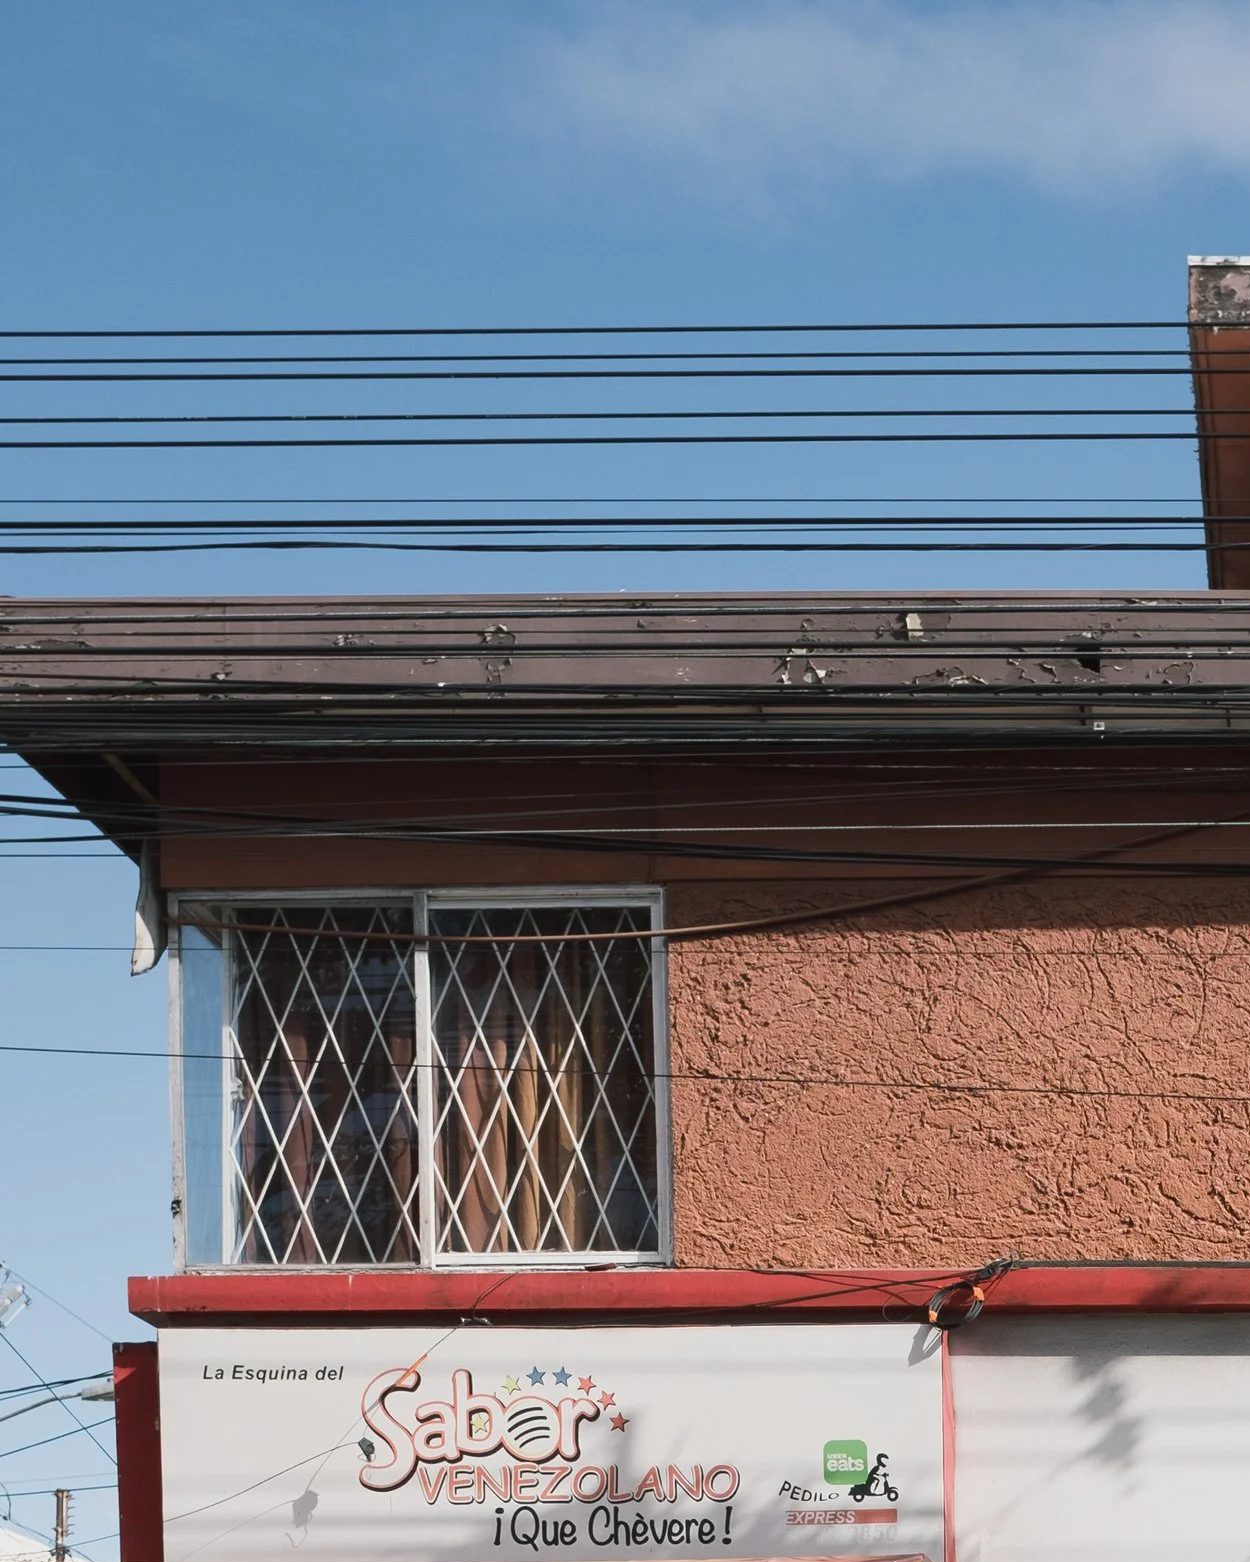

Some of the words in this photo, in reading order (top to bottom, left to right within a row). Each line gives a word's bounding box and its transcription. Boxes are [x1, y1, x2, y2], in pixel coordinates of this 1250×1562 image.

[202, 1365, 225, 1380] La
[231, 1365, 308, 1383] Esquina
[315, 1365, 344, 1381] del
[359, 1367, 600, 1493] Sabor
[826, 1457, 864, 1472] eats
[416, 1464, 741, 1504] VENEZOLANO
[778, 1480, 840, 1502] PEDILO
[786, 1510, 857, 1524] EXPRESS
